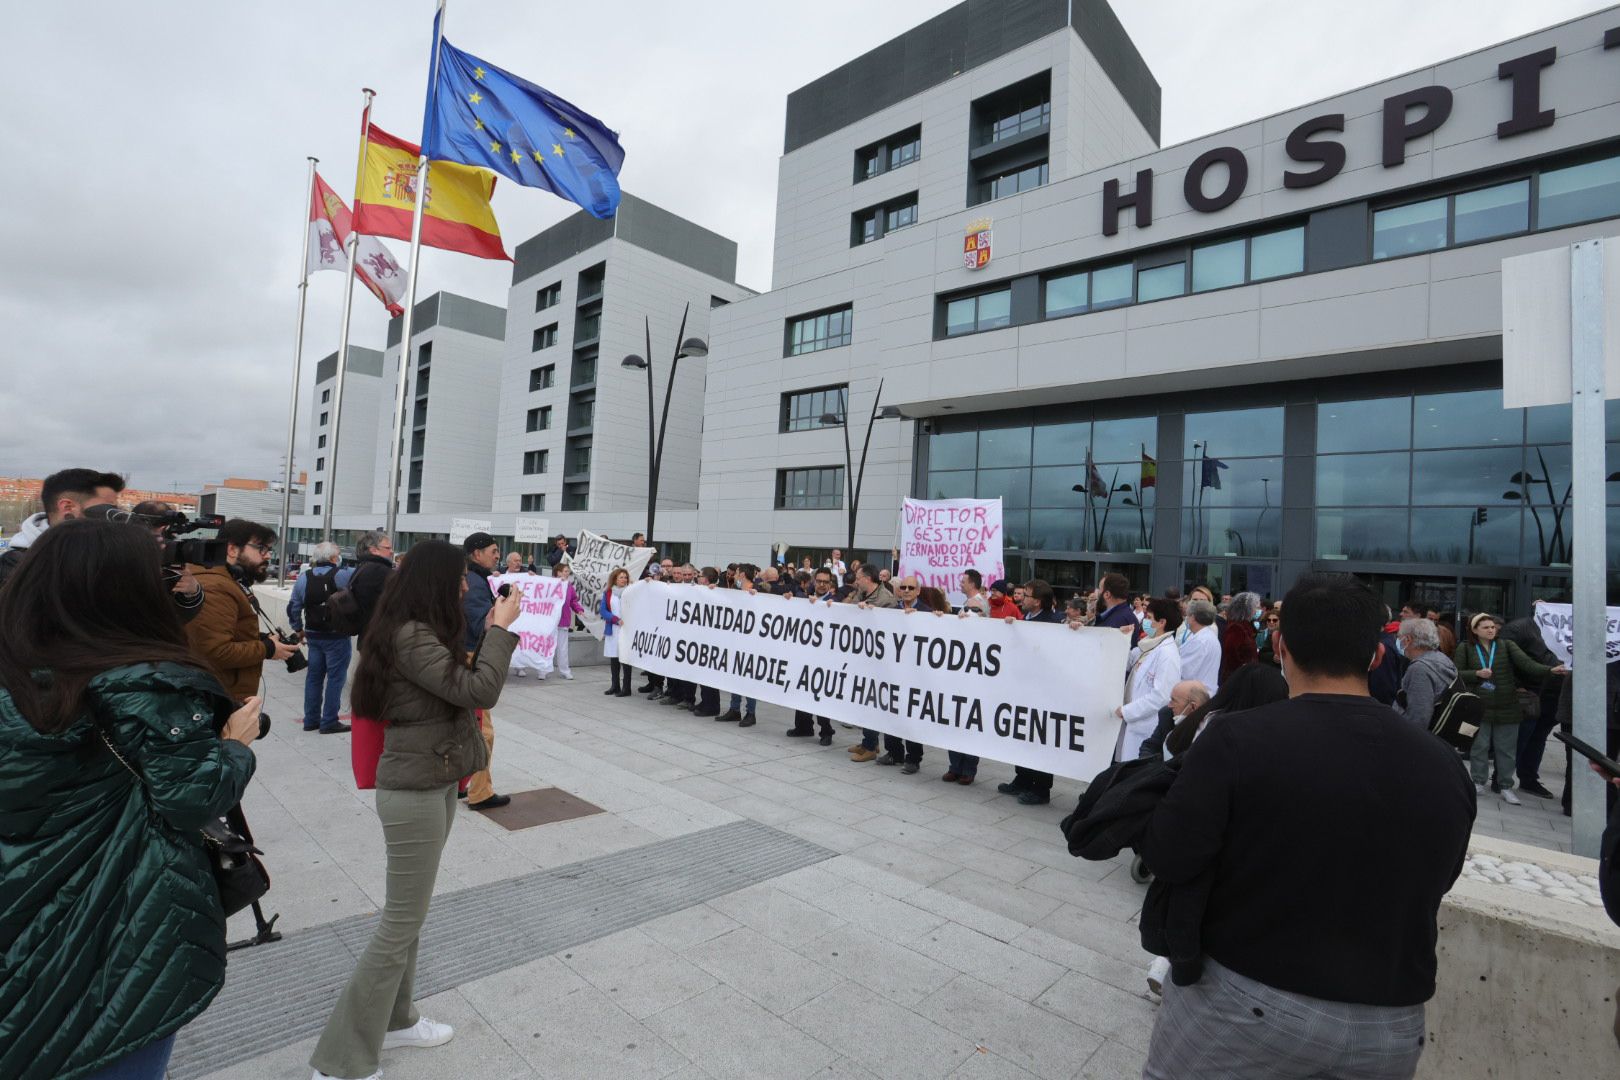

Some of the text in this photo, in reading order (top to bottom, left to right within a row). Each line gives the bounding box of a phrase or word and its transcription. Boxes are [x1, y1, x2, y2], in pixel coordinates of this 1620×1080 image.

[1102, 27, 1620, 237] HOSPI
[905, 503, 987, 526] DIRECTOR
[914, 524, 999, 542] GESTION
[666, 598, 1002, 677] LA SANIDAD SOMOS TODOS Y TODAS
[632, 627, 1086, 753] AQUÍ NO SOBRA NADIE, AQUÍ HACE FALTA GENTE
